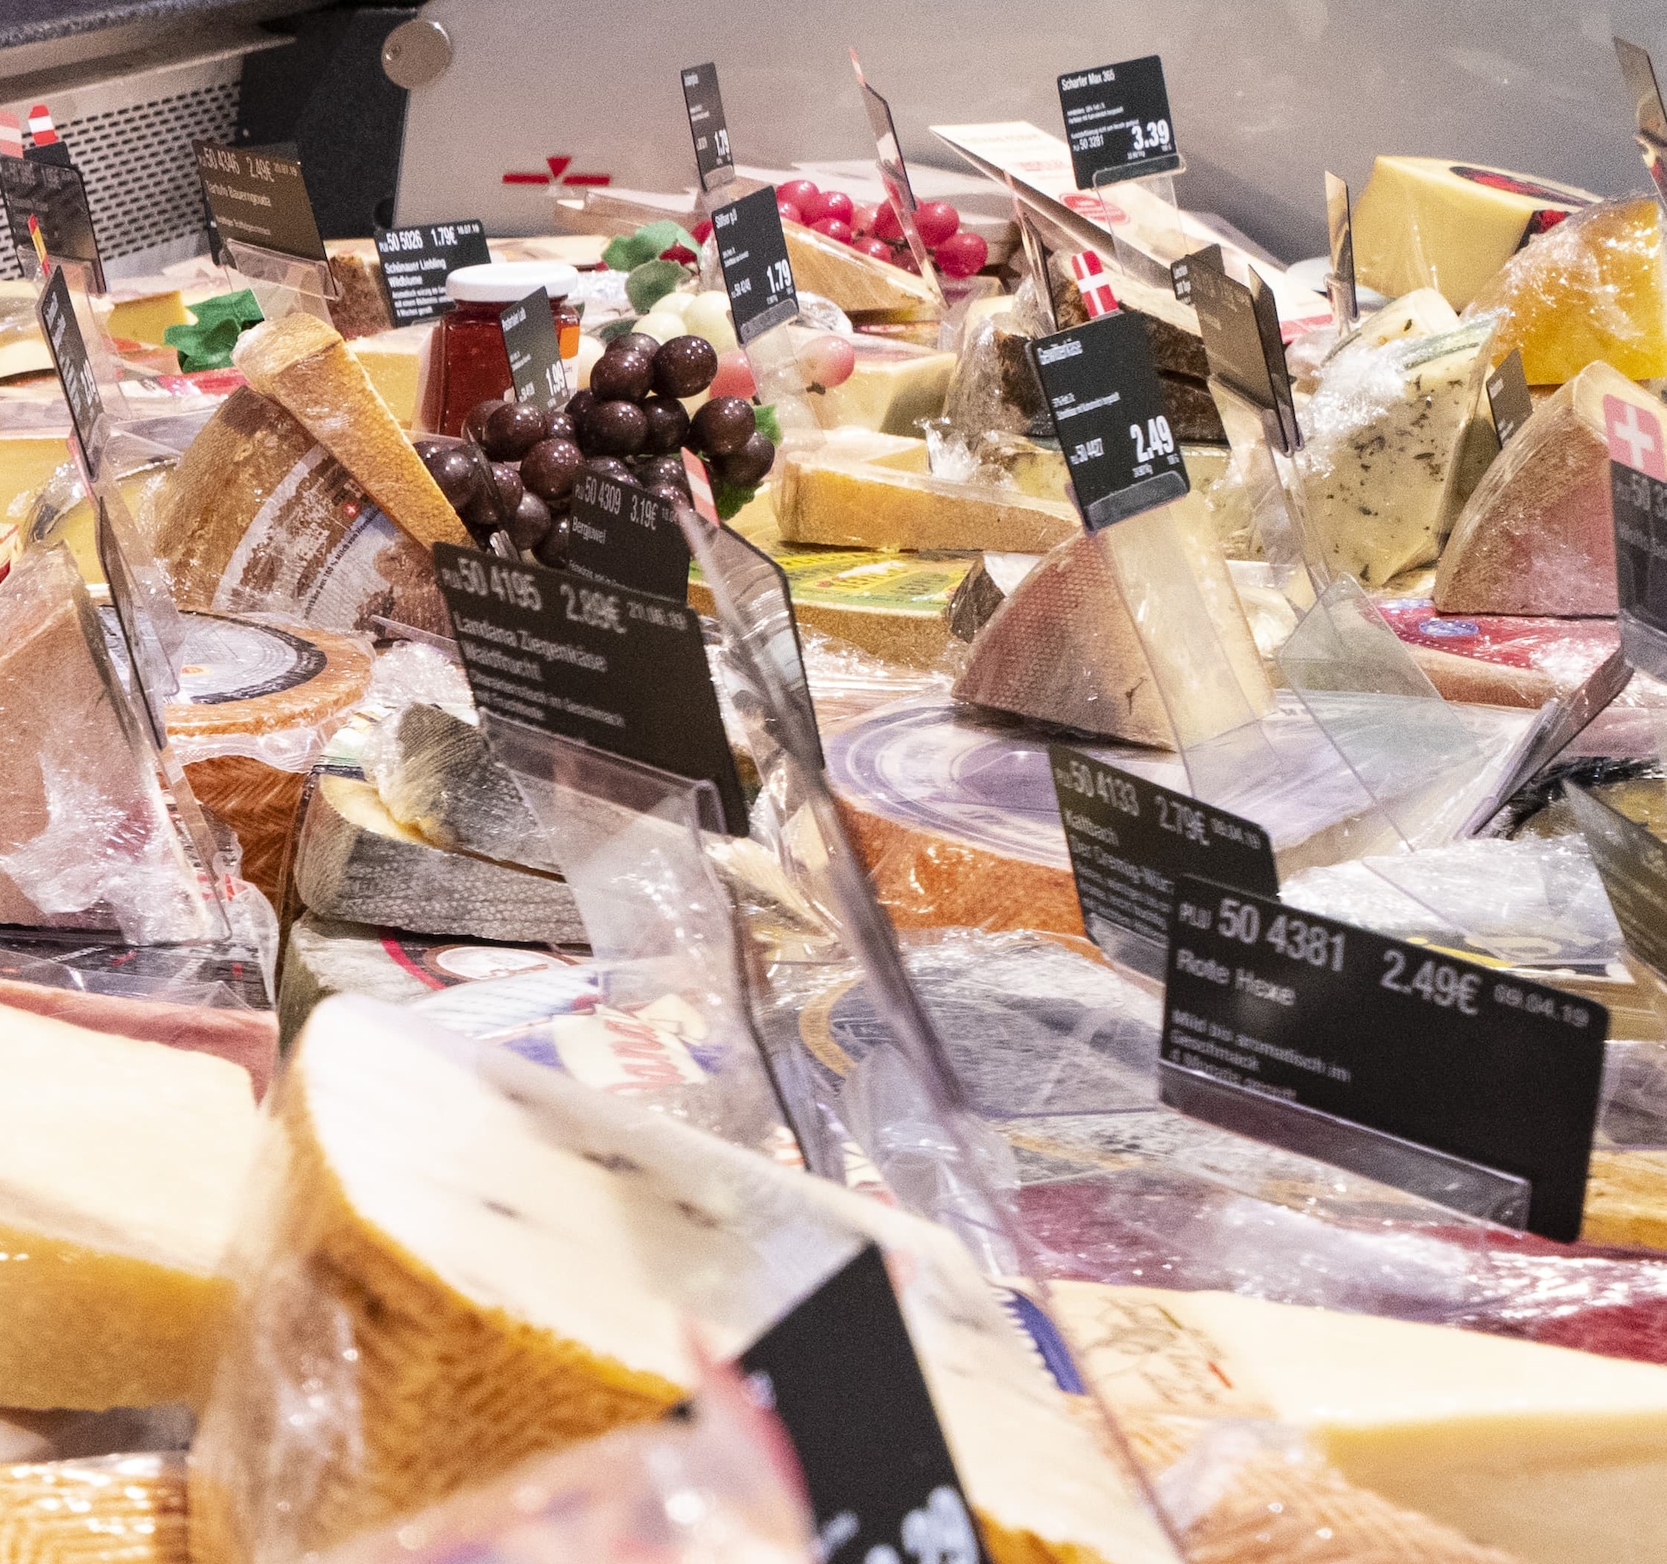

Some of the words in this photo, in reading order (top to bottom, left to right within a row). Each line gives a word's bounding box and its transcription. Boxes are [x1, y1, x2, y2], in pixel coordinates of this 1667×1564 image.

[1062, 75, 1088, 91] Scharfer
[1088, 72, 1103, 85] Max
[1102, 69, 1115, 82] 365
[1131, 119, 1170, 150] 3.39
[246, 156, 275, 182] 2.49€
[386, 232, 400, 252] 50
[400, 229, 423, 250] 5026
[431, 226, 458, 247] 1.79€
[767, 259, 791, 294] 1.79
[546, 360, 565, 396] 1.99
[1130, 415, 1174, 463] 2.49
[598, 482, 621, 515] 4309
[630, 495, 658, 530] 3.19€
[1218, 897, 1261, 945] 50
[1266, 914, 1346, 973] 4381
[1382, 950, 1483, 1017] 2.49€
[1176, 948, 1230, 985] Rote
[1234, 966, 1297, 1006] Hexe
